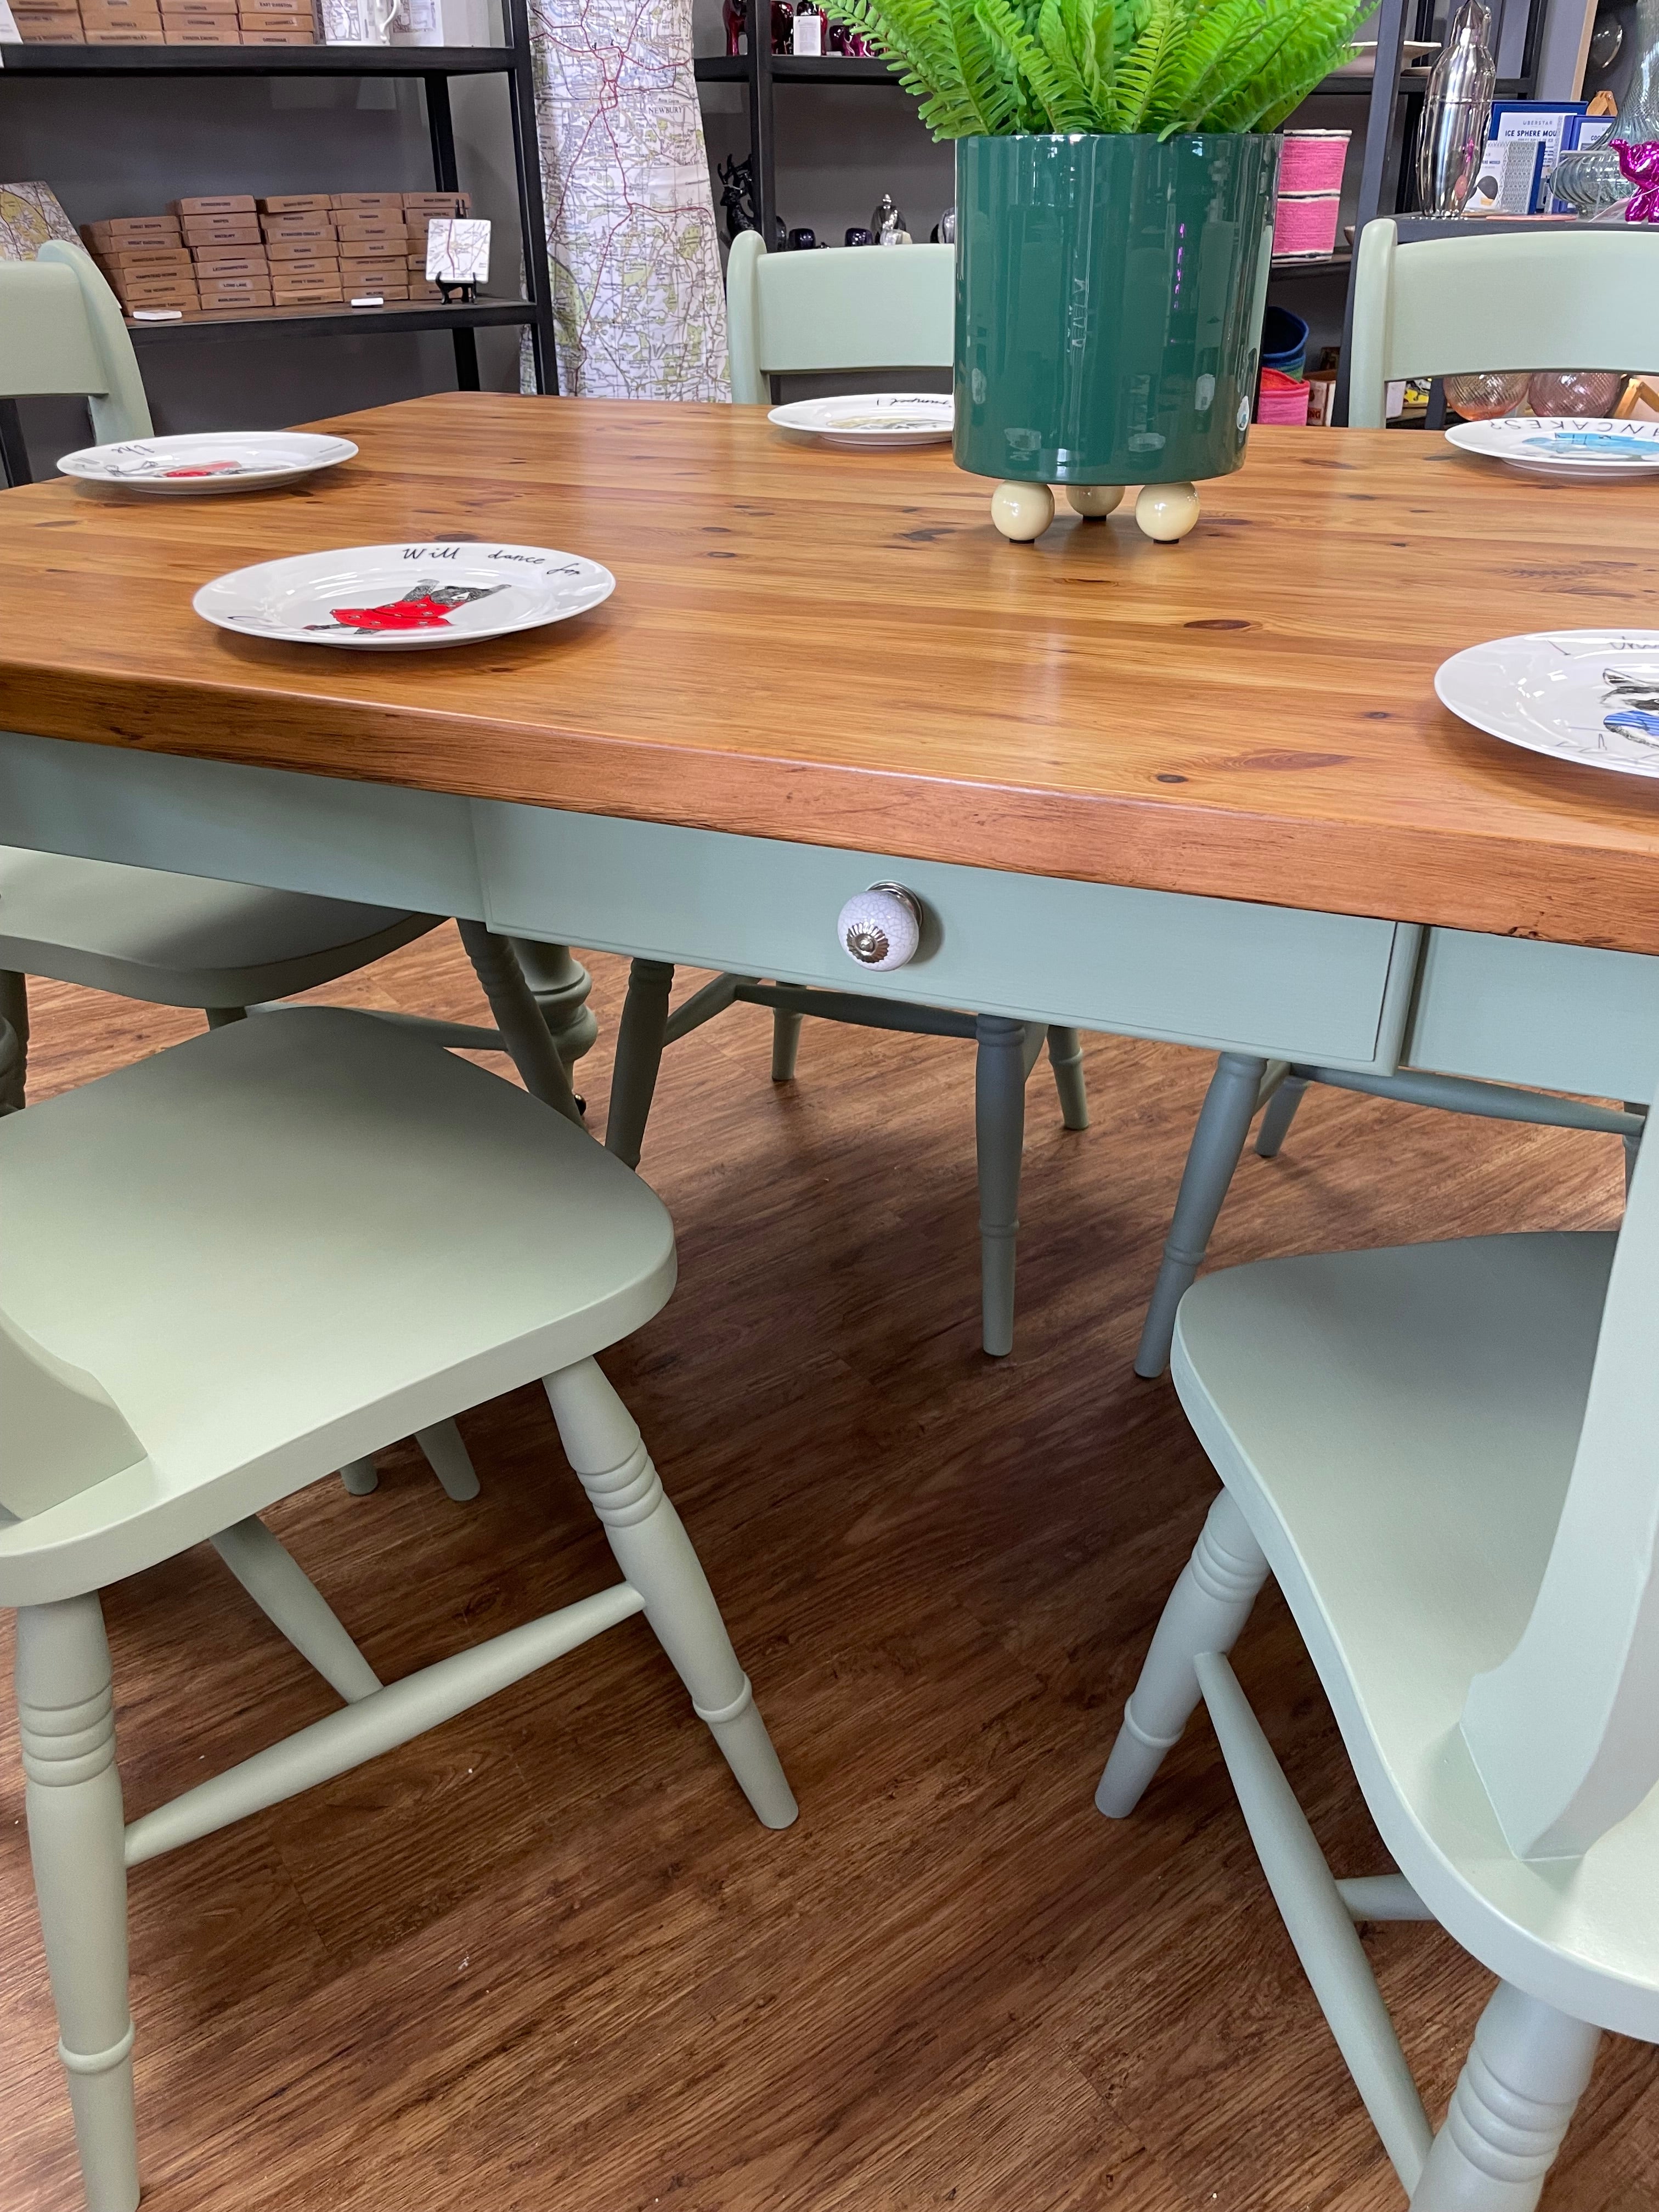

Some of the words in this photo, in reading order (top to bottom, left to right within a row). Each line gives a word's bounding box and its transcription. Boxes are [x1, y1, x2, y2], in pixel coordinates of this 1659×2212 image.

[648, 105, 682, 114] NEWBURY
[402, 547, 460, 560] Will
[488, 550, 545, 564] dance
[546, 563, 580, 576] for
